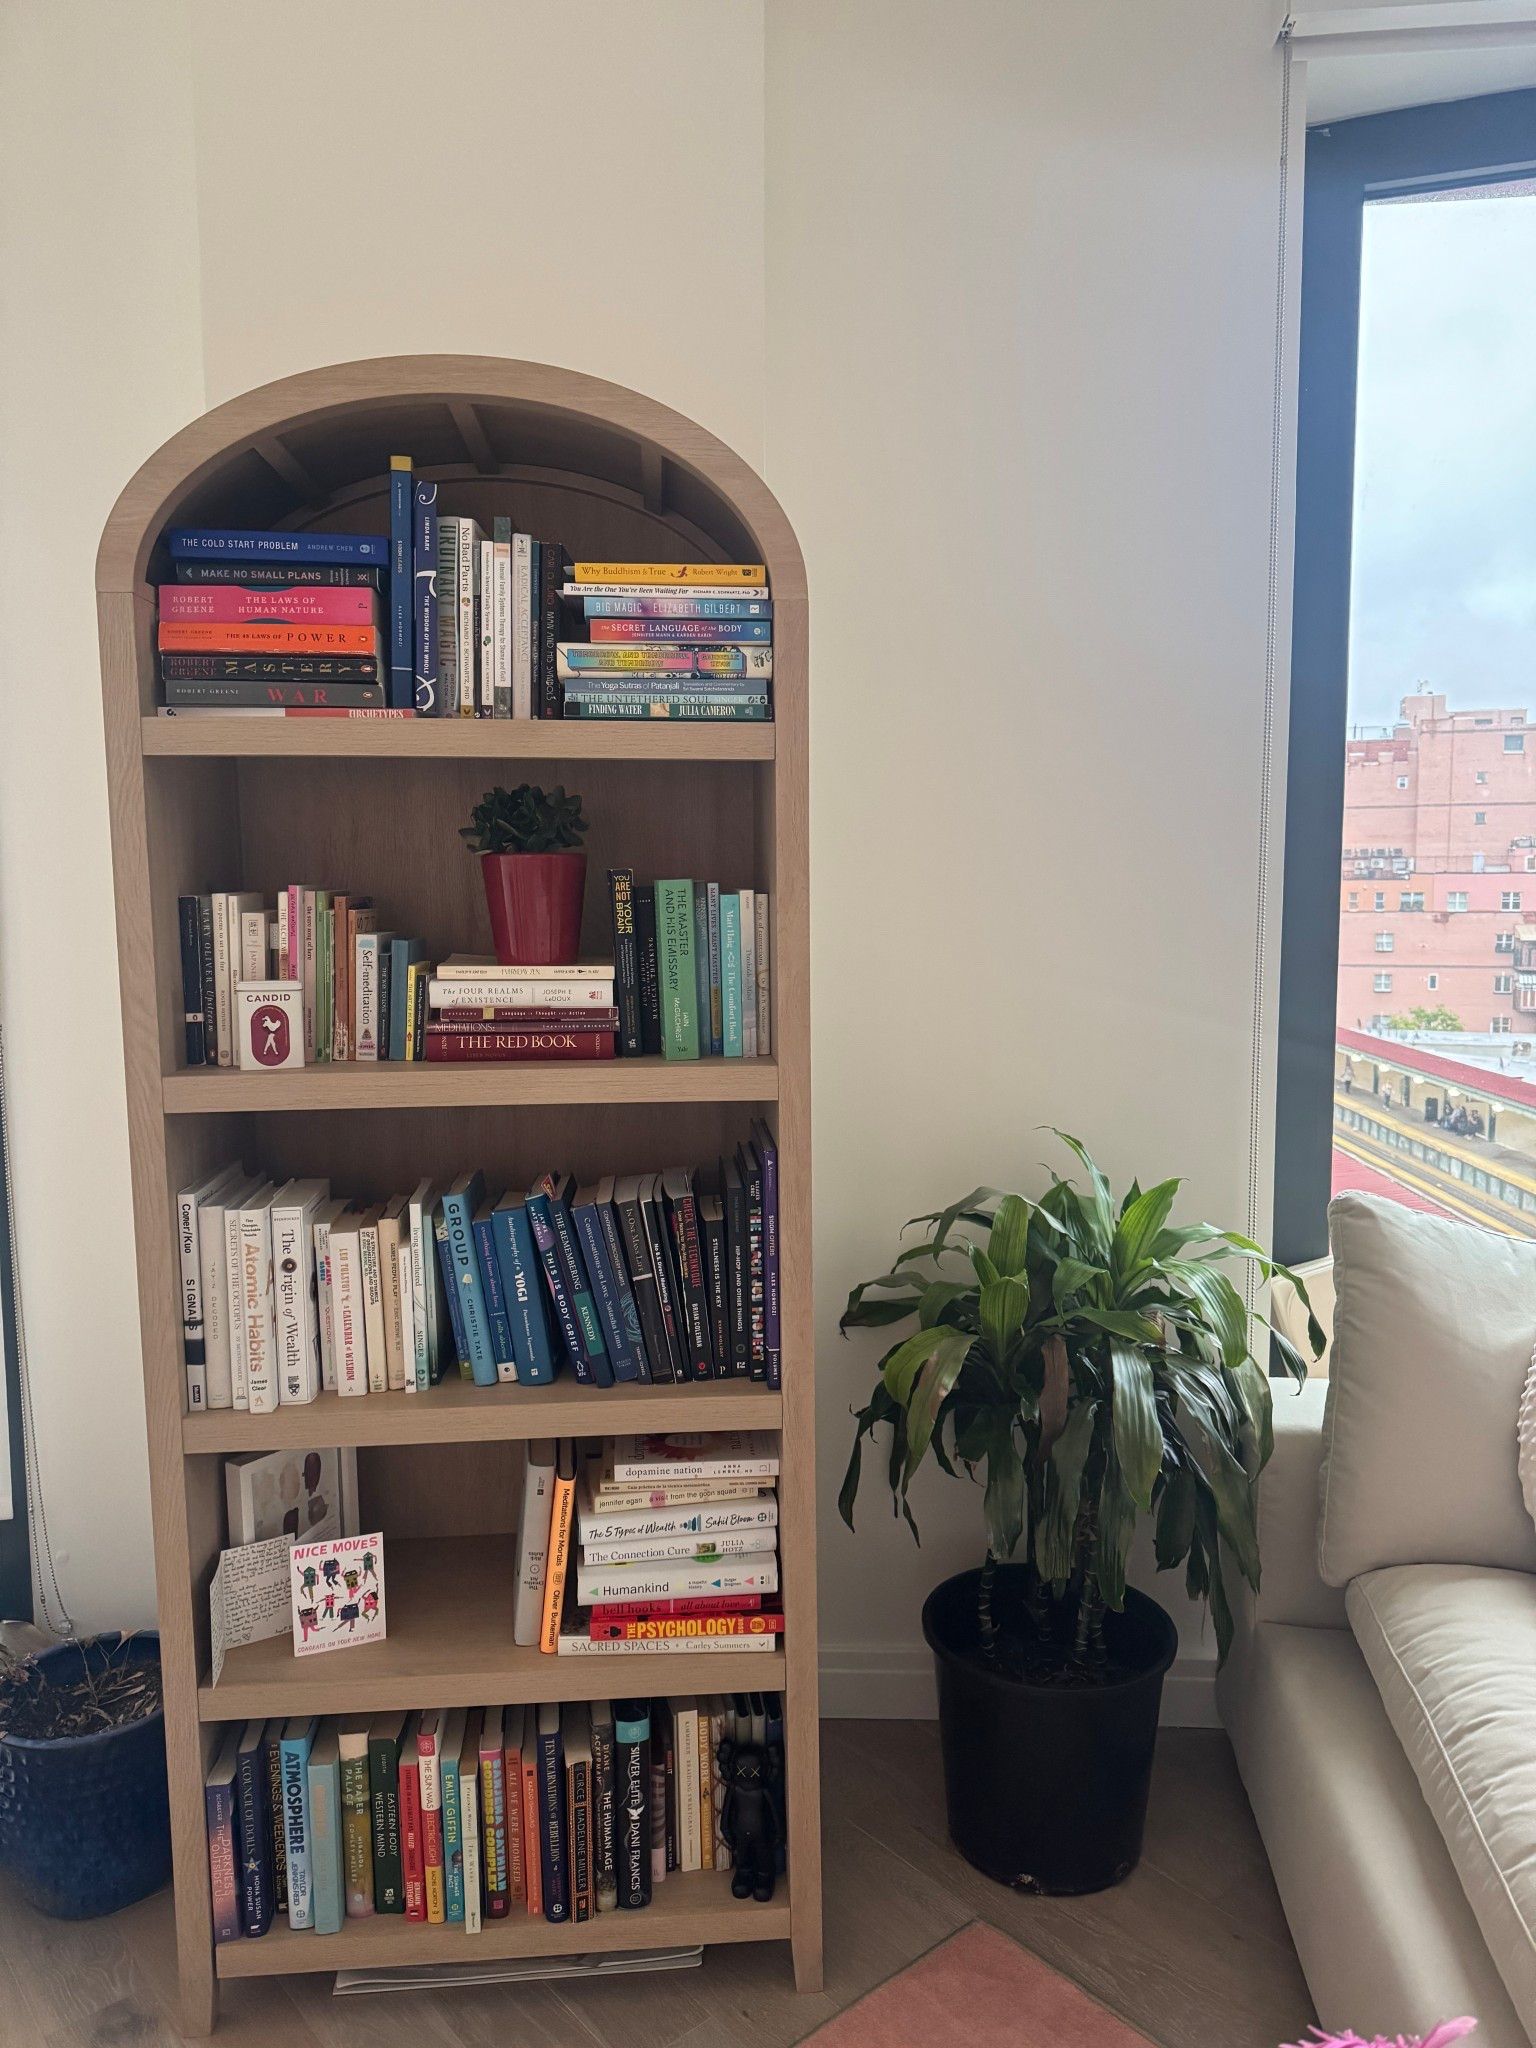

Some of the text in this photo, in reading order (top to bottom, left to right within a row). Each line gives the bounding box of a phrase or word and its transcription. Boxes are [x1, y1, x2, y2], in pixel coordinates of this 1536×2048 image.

[182, 538, 298, 551] THE COLD START PROBLEM
[461, 527, 470, 592] No Bad Parts
[201, 569, 230, 578] MAKE
[233, 570, 248, 578] NO
[251, 570, 284, 579] SMALL
[288, 571, 321, 580] PLANS
[582, 567, 602, 575] Why
[603, 567, 641, 575] Buddhism
[238, 606, 277, 614] HUMAN
[246, 596, 266, 604] THE
[596, 602, 642, 613] BIG MAGIC
[653, 603, 740, 614] ELIZABETH GILBERT
[287, 632, 346, 643] POWER
[225, 661, 351, 674] MASTERY
[268, 688, 327, 703] WAR
[589, 704, 642, 715] FINDING WATER
[679, 705, 736, 716] JULIA CAMERON
[615, 882, 630, 890] ARE
[616, 891, 631, 900] NOT
[616, 902, 625, 934] BRAIN
[623, 902, 633, 934] YOUR
[677, 889, 689, 956] THE MASTER
[202, 908, 213, 983] MARY OLIVER
[665, 889, 678, 991] AND HIS EMISSARY
[246, 994, 291, 1003] CANDID
[362, 950, 373, 1025] Self-meditation
[451, 996, 459, 1004] of
[459, 987, 483, 995] FOUR
[206, 990, 215, 1032] Upstream
[673, 998, 682, 1042] McGILCHRIST
[456, 1035, 577, 1049] THE RED BOOK
[182, 1204, 193, 1254] Comer/Kuo
[282, 1230, 295, 1255] The
[448, 1203, 469, 1266] GROUP
[412, 1227, 422, 1286] living untethered
[554, 1212, 582, 1290] THE REMEMBERING
[712, 1238, 721, 1271] STILLNESS
[514, 1271, 528, 1302] YOGI
[715, 1273, 721, 1281] IS
[186, 1279, 198, 1331] SIGNALS
[245, 1243, 264, 1372] Atomic Habits
[284, 1308, 297, 1321] of
[546, 1252, 579, 1352] THIS IS BODY GRIEF
[467, 1298, 483, 1361] CHRISTIE TATE
[581, 1306, 596, 1341] KENNEDY
[692, 1303, 703, 1348] BRIAN COLEMAN
[286, 1322, 299, 1367] Wealth
[625, 1465, 703, 1477] dopamine nation
[599, 1498, 643, 1508] jennifer egan
[556, 1488, 570, 1566] Meditations for Mortals
[589, 1522, 677, 1540] The 5 Types of Wealth
[705, 1515, 754, 1528] Sahil Bloom
[293, 1537, 378, 1560] NICE MOVES
[589, 1546, 690, 1562] The Connection Cure
[603, 1582, 669, 1596] Humankind
[549, 1590, 561, 1646] Oliver Burkeman
[603, 1604, 625, 1614] bell
[627, 1623, 637, 1639] THE
[637, 1618, 736, 1638] PSYCHOLOGY
[571, 1641, 670, 1652] SACRED SPACES
[686, 1640, 750, 1650] Carley Summers
[699, 1721, 709, 1784] BODY WORK
[576, 1773, 585, 1800] CIRCE
[631, 1747, 640, 1805] SILVER ELITE
[285, 1751, 304, 1854] ATMOSPHERE
[424, 1759, 437, 1864] THE SUN WAS ELECTRIC LIGHT
[445, 1774, 456, 1843] EMILY GIFFIN
[375, 1791, 386, 1858] WESTERN MIND
[387, 1793, 397, 1856] EASTERN BODY
[603, 1791, 613, 1871] THE HUMAN AGE
[577, 1808, 586, 1890] MADELINE MILLER
[631, 1823, 641, 1890] DANI FRANCIS
[291, 1861, 301, 1906] JENKINS REID
